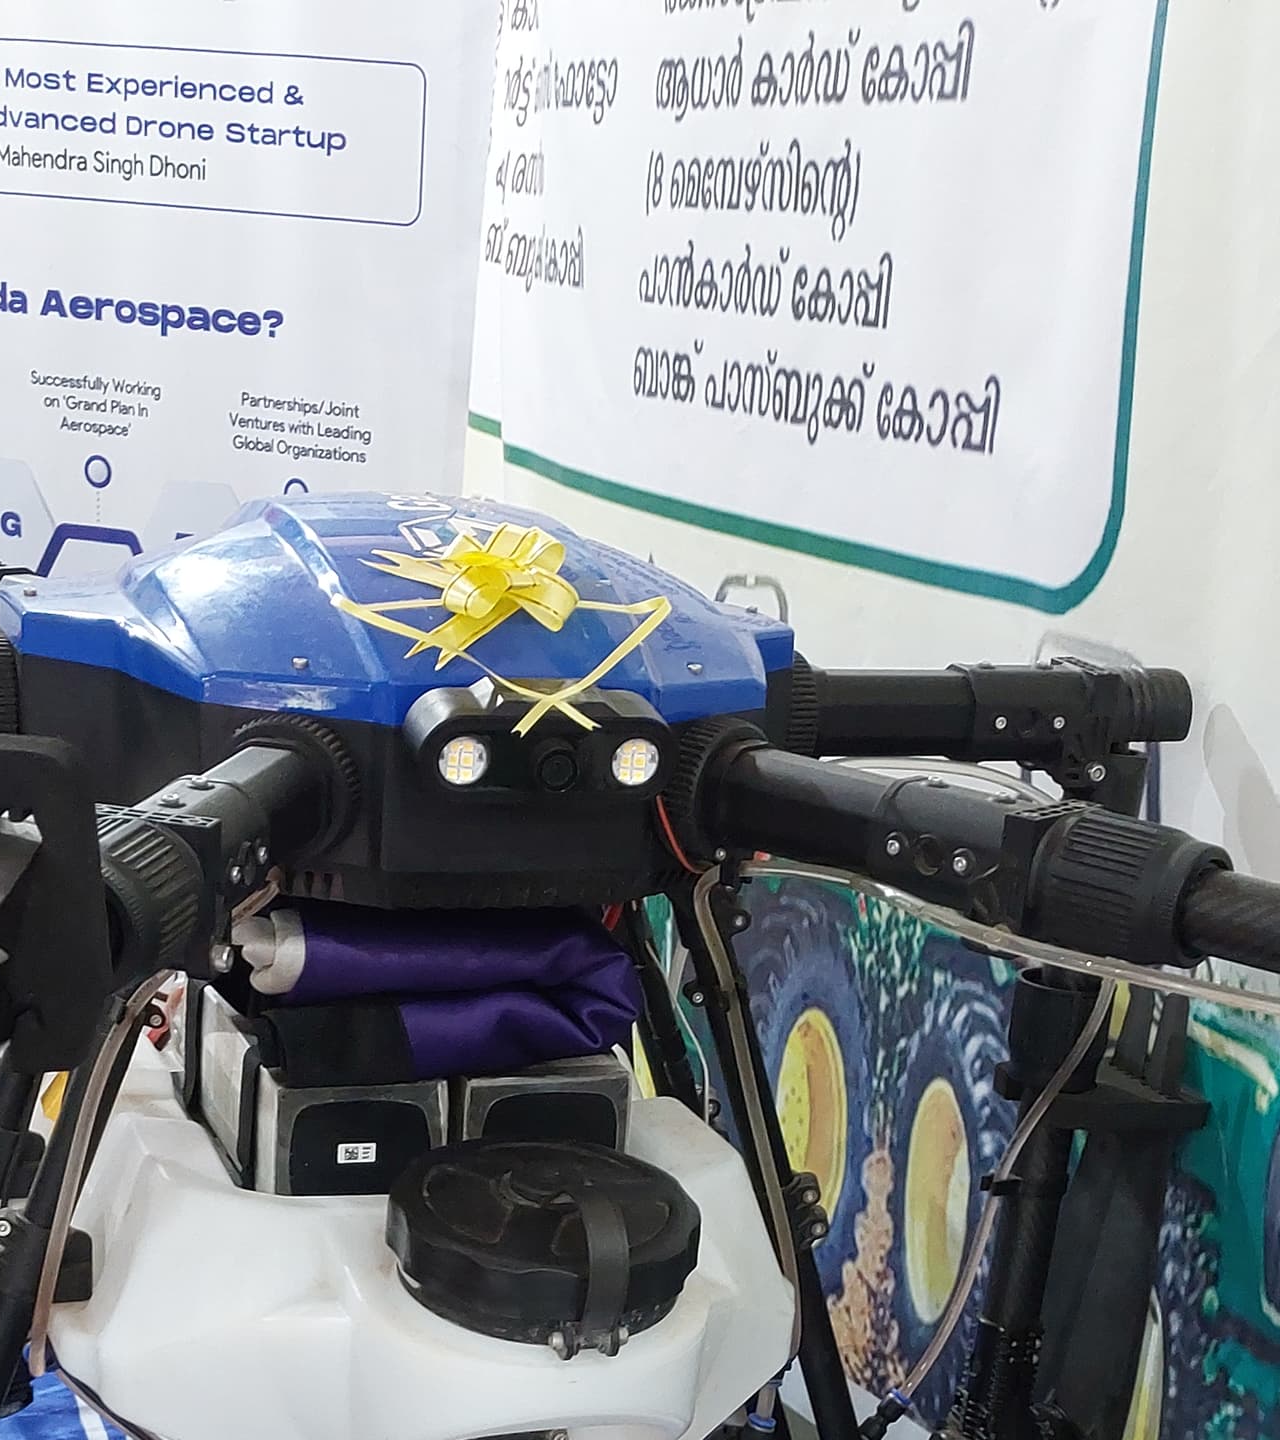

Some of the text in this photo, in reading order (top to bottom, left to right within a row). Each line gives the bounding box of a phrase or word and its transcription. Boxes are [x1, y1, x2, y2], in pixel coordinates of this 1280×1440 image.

[5, 67, 76, 91] Most
[88, 73, 273, 103] Experienced
[283, 85, 304, 106] &
[126, 116, 215, 141] Drone
[225, 123, 347, 156] Startup
[93, 151, 144, 181] Singh
[149, 155, 206, 181] Dhoni
[40, 288, 284, 338] Aerospace?
[31, 370, 161, 401] Successfully Working
[44, 396, 60, 408] on
[111, 400, 135, 415] Plan
[229, 412, 371, 445] Ventures with Leading
[232, 434, 366, 463] Global Organizations
